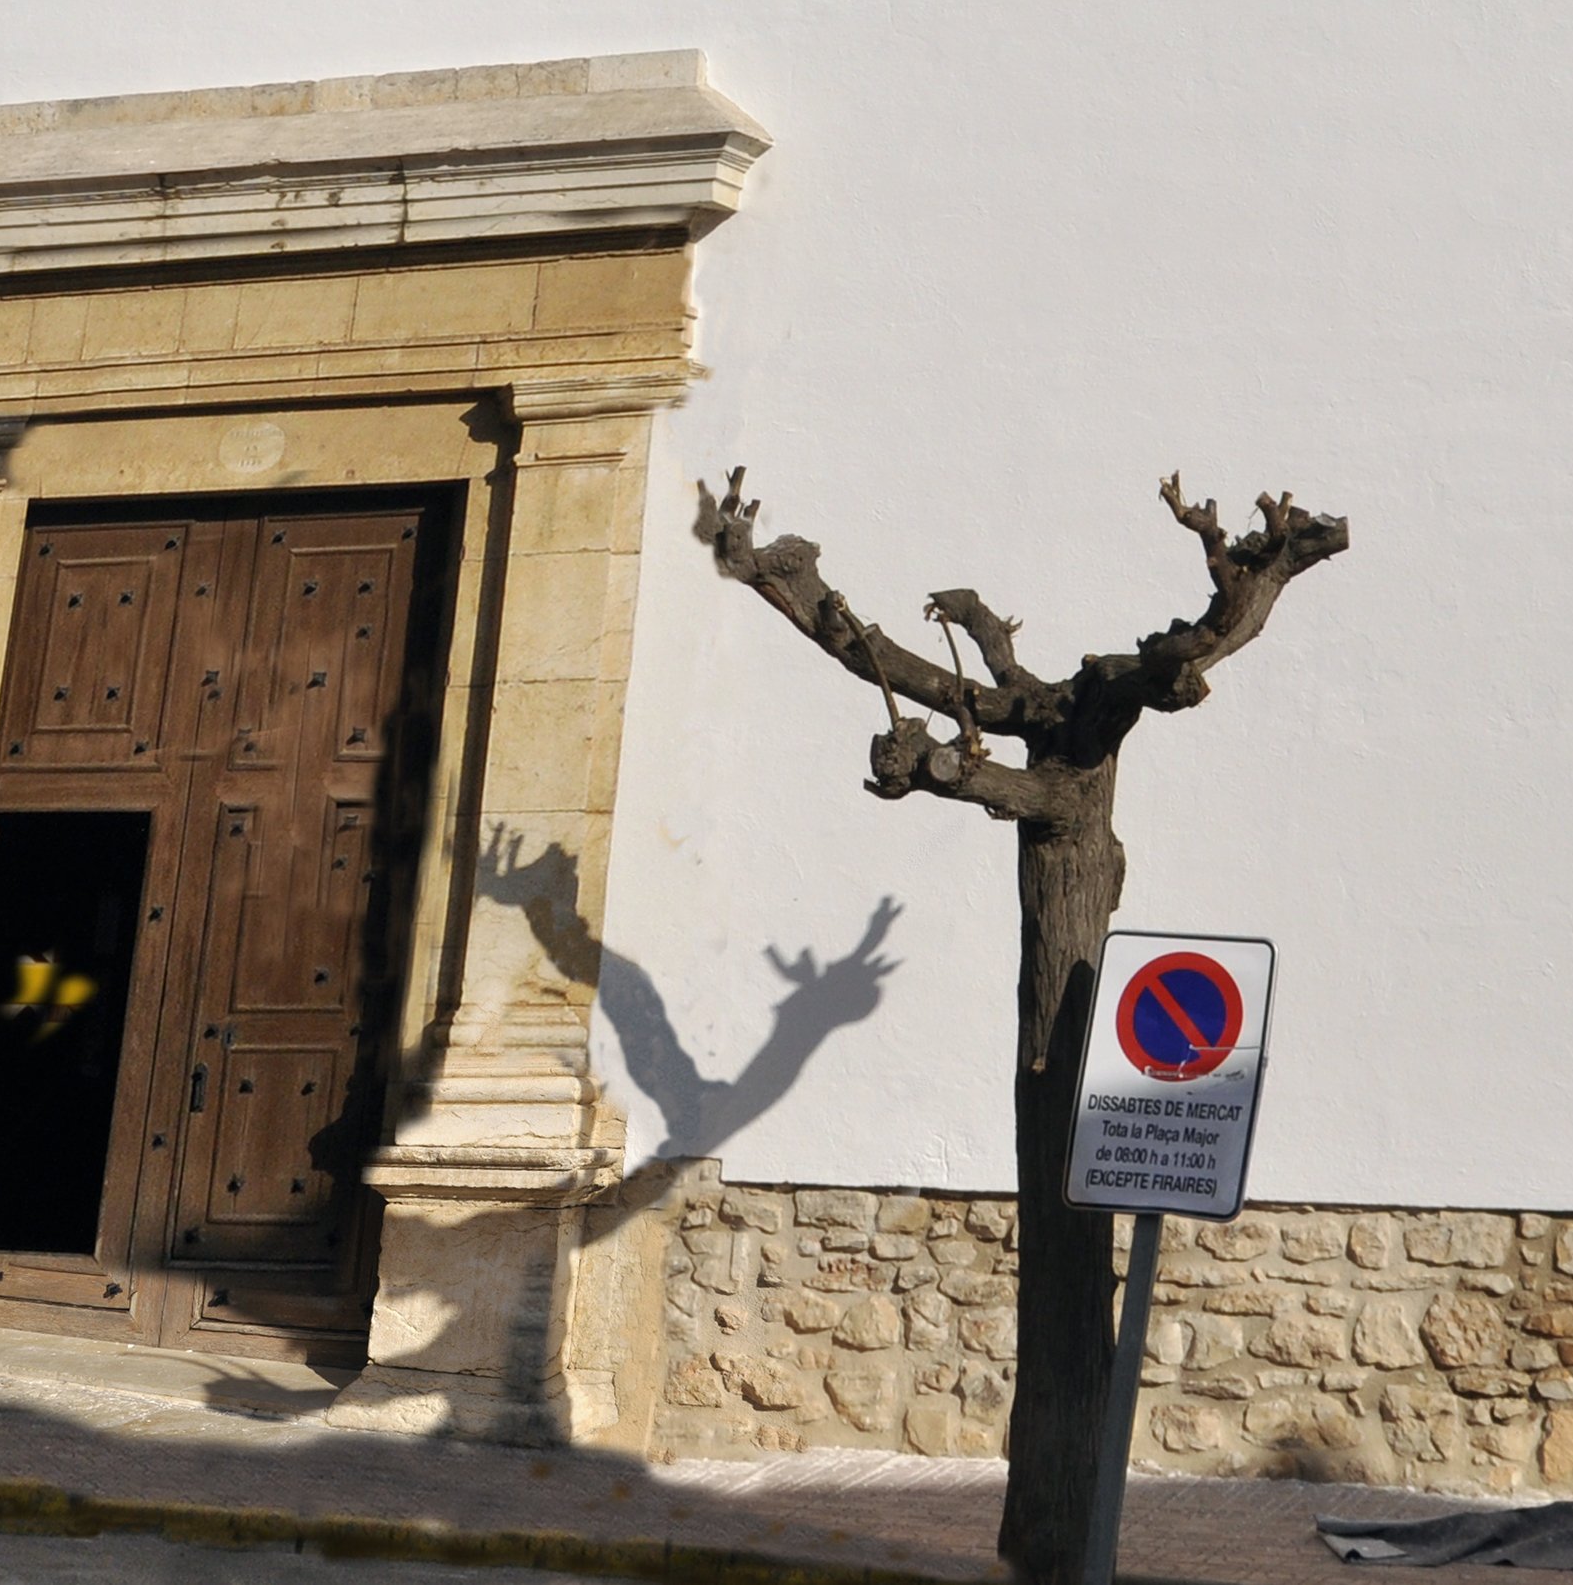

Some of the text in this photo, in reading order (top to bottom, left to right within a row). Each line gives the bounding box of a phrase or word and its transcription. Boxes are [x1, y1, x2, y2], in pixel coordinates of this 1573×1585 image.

[1087, 1094, 1243, 1121] DISSABTES DE MERCAT
[1102, 1120, 1220, 1147] Tota la Plaça Major
[1095, 1145, 1216, 1169] de 08:00 h a 11:00 h
[1085, 1169, 1218, 1198] (EXCEPTE FIRAIRES)
